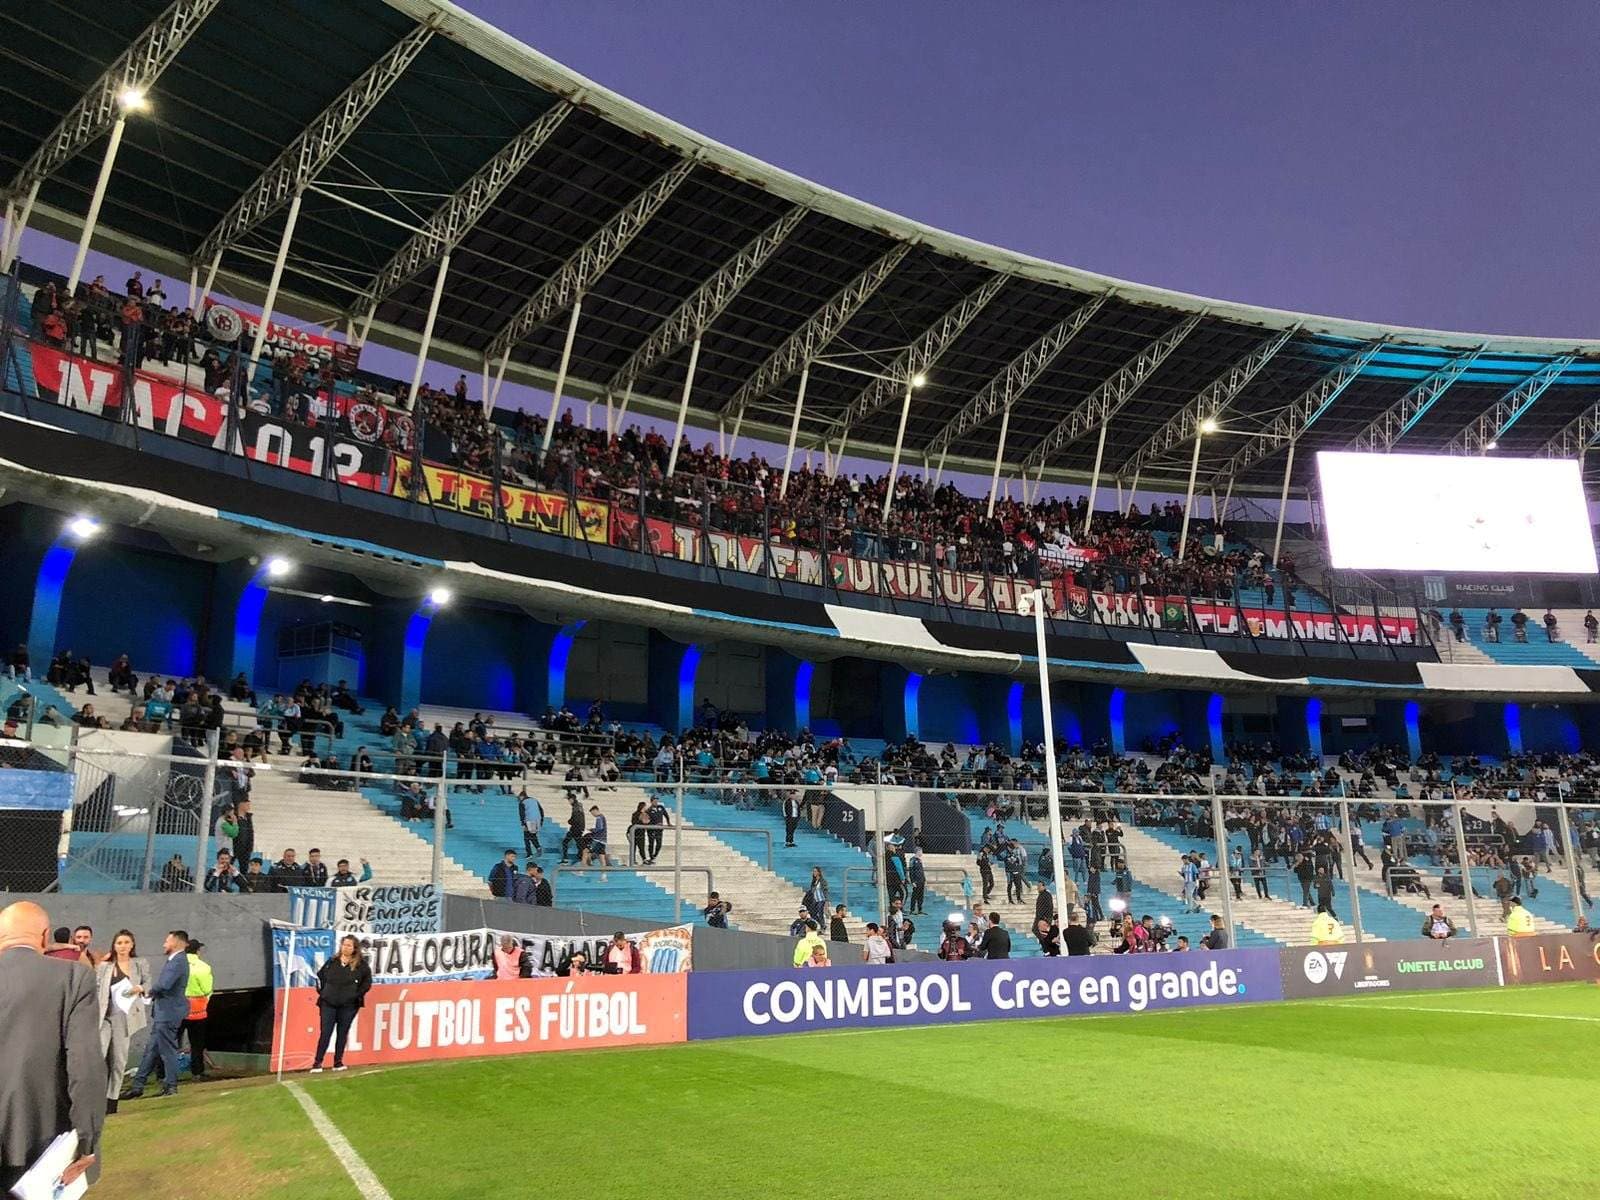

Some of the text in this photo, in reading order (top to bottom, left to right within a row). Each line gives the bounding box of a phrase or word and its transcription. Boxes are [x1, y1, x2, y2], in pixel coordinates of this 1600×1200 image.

[842, 810, 854, 822] 25
[1471, 820, 1483, 830] 23
[293, 887, 335, 900] RACING
[355, 884, 435, 903] RACING
[343, 901, 438, 922] SIEMPRE
[409, 932, 496, 975] LOCURA
[1539, 944, 1575, 971] LA
[1397, 958, 1484, 973] ÚNETE AL CLUB
[742, 973, 972, 1025] CONMEBOL
[991, 971, 1072, 1010] Cree
[1079, 975, 1120, 1005] en
[373, 988, 485, 1051] FÚTBOL
[494, 997, 531, 1043] ES
[540, 982, 647, 1041] FÚTBOL
